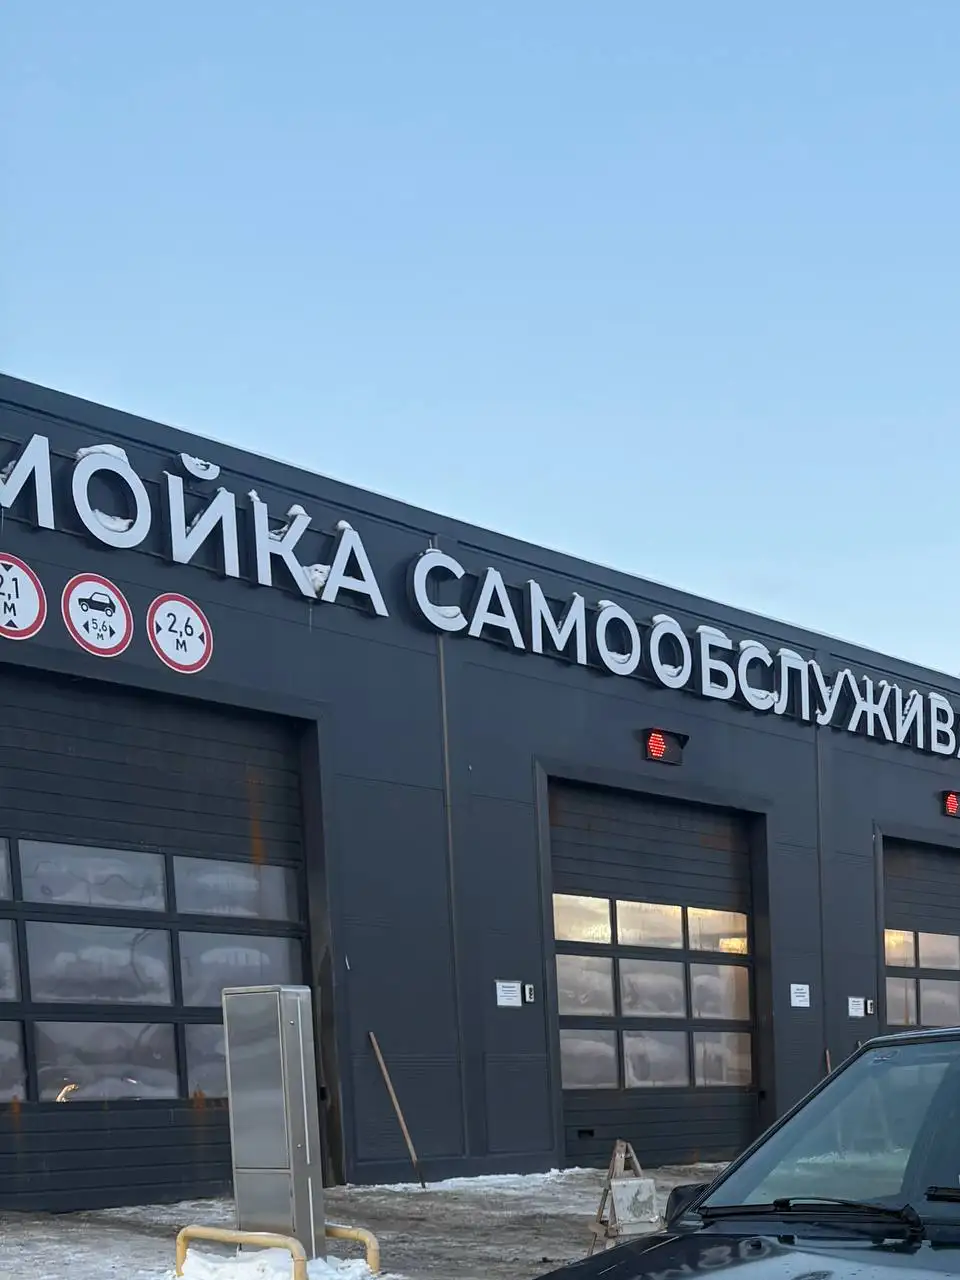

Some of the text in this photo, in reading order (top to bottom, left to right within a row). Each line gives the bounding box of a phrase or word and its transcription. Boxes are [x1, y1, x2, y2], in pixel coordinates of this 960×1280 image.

[91, 618, 108, 633] 5,6
[166, 612, 194, 638] 2,6
[175, 638, 188, 653] М
